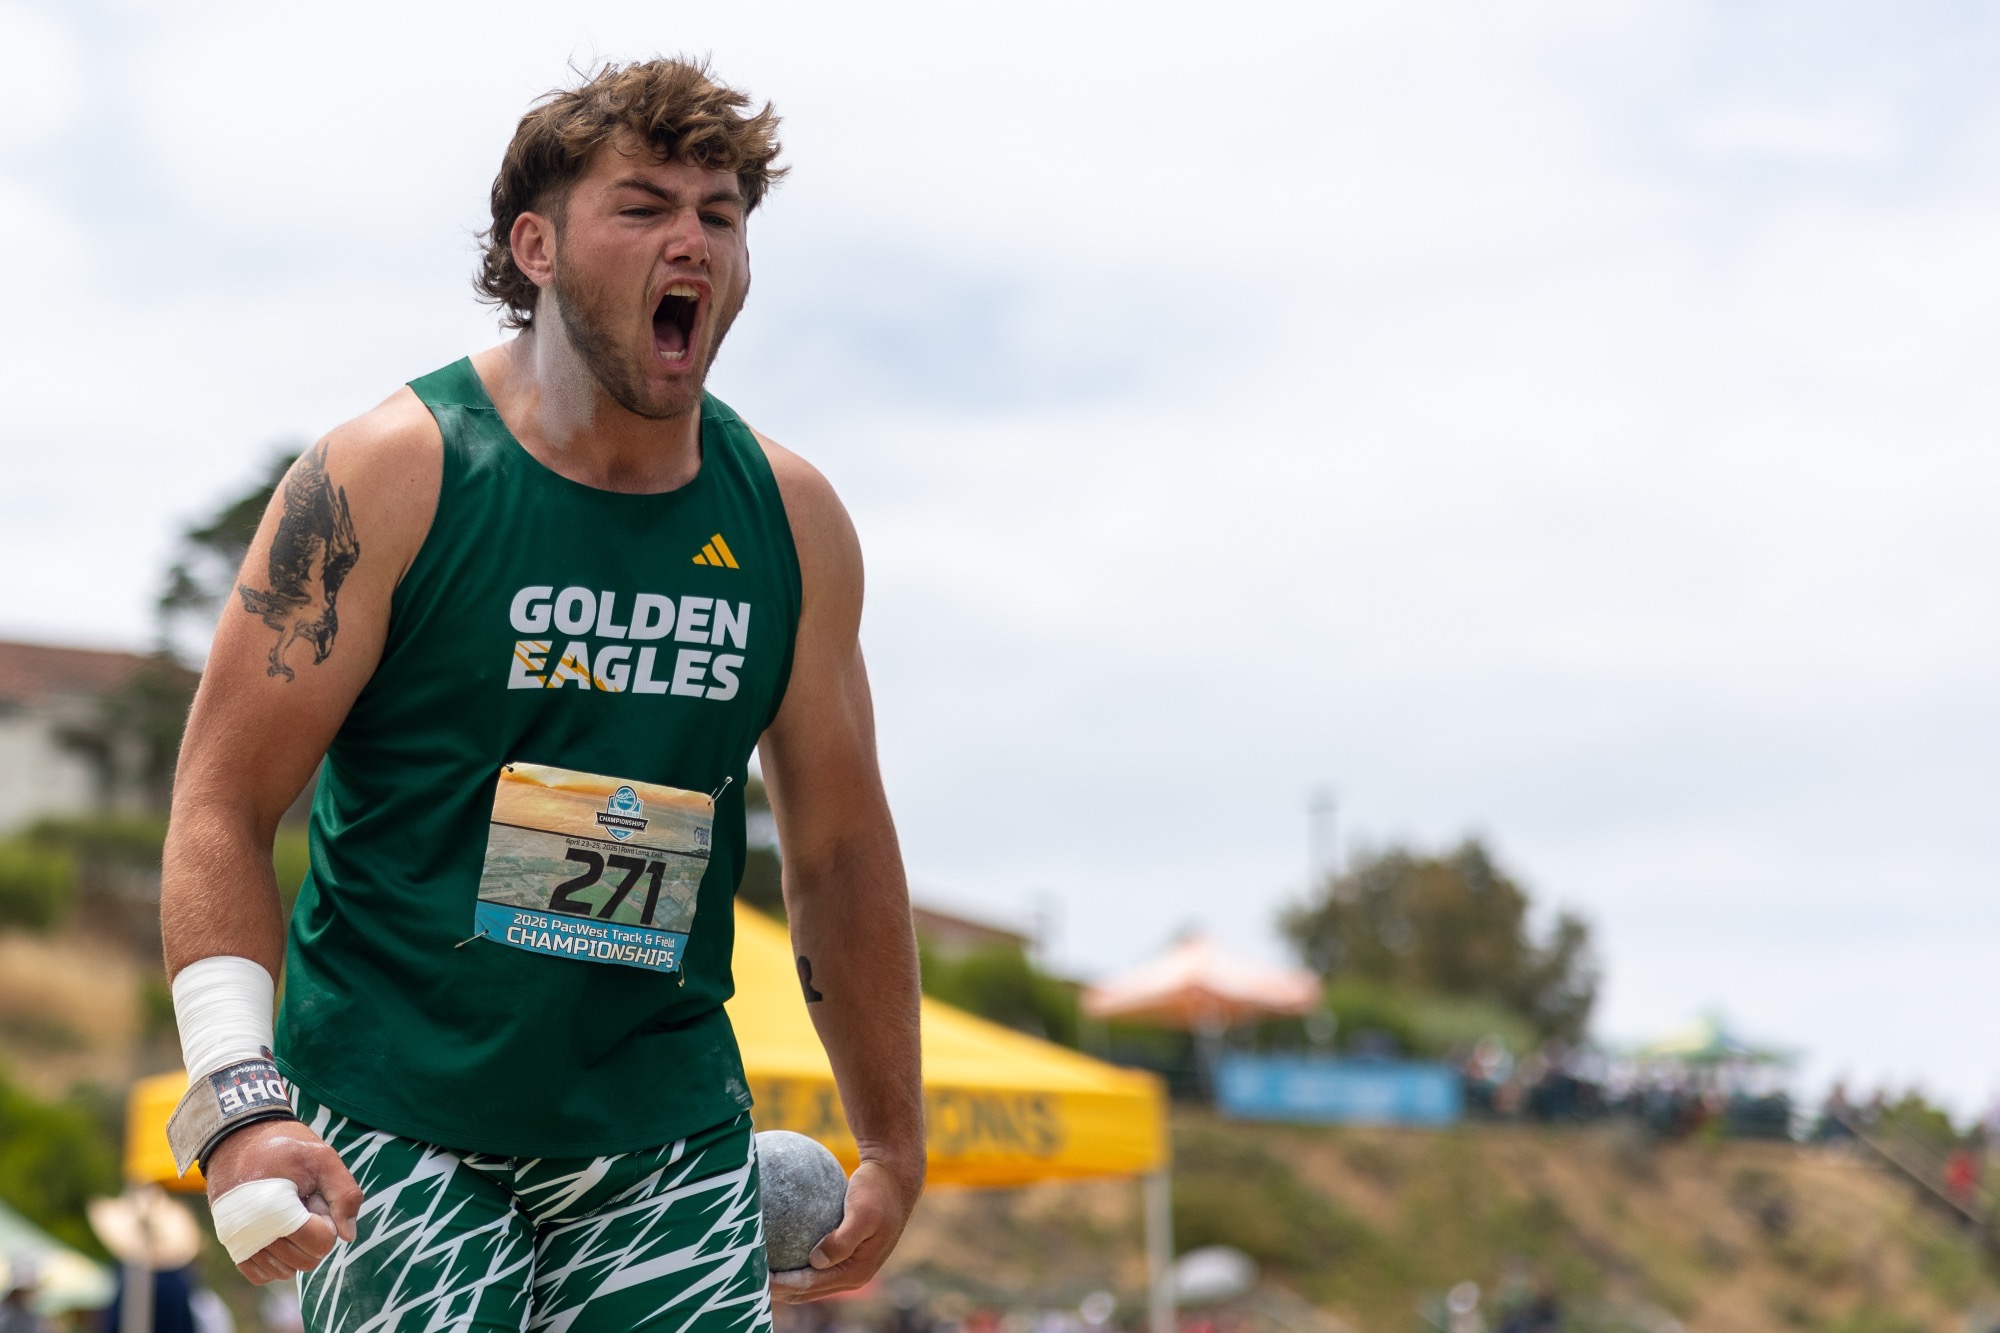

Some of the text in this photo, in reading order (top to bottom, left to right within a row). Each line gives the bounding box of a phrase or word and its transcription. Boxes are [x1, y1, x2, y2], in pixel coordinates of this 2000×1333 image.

[509, 585, 751, 650] GOLDEN
[507, 640, 745, 702] EAGLES
[599, 815, 645, 828] CHAMPIONSHIPS
[565, 838, 580, 846] April
[581, 840, 601, 850] 23-25,
[602, 843, 618, 852] 2026
[621, 846, 634, 855] Point
[548, 847, 666, 925] 271
[506, 926, 674, 968] CHAMPIONSHIPS
[513, 913, 675, 949] 2026 PacWest Track & Field
[230, 1064, 266, 1078] THROWS
[219, 1079, 288, 1113] DHE
